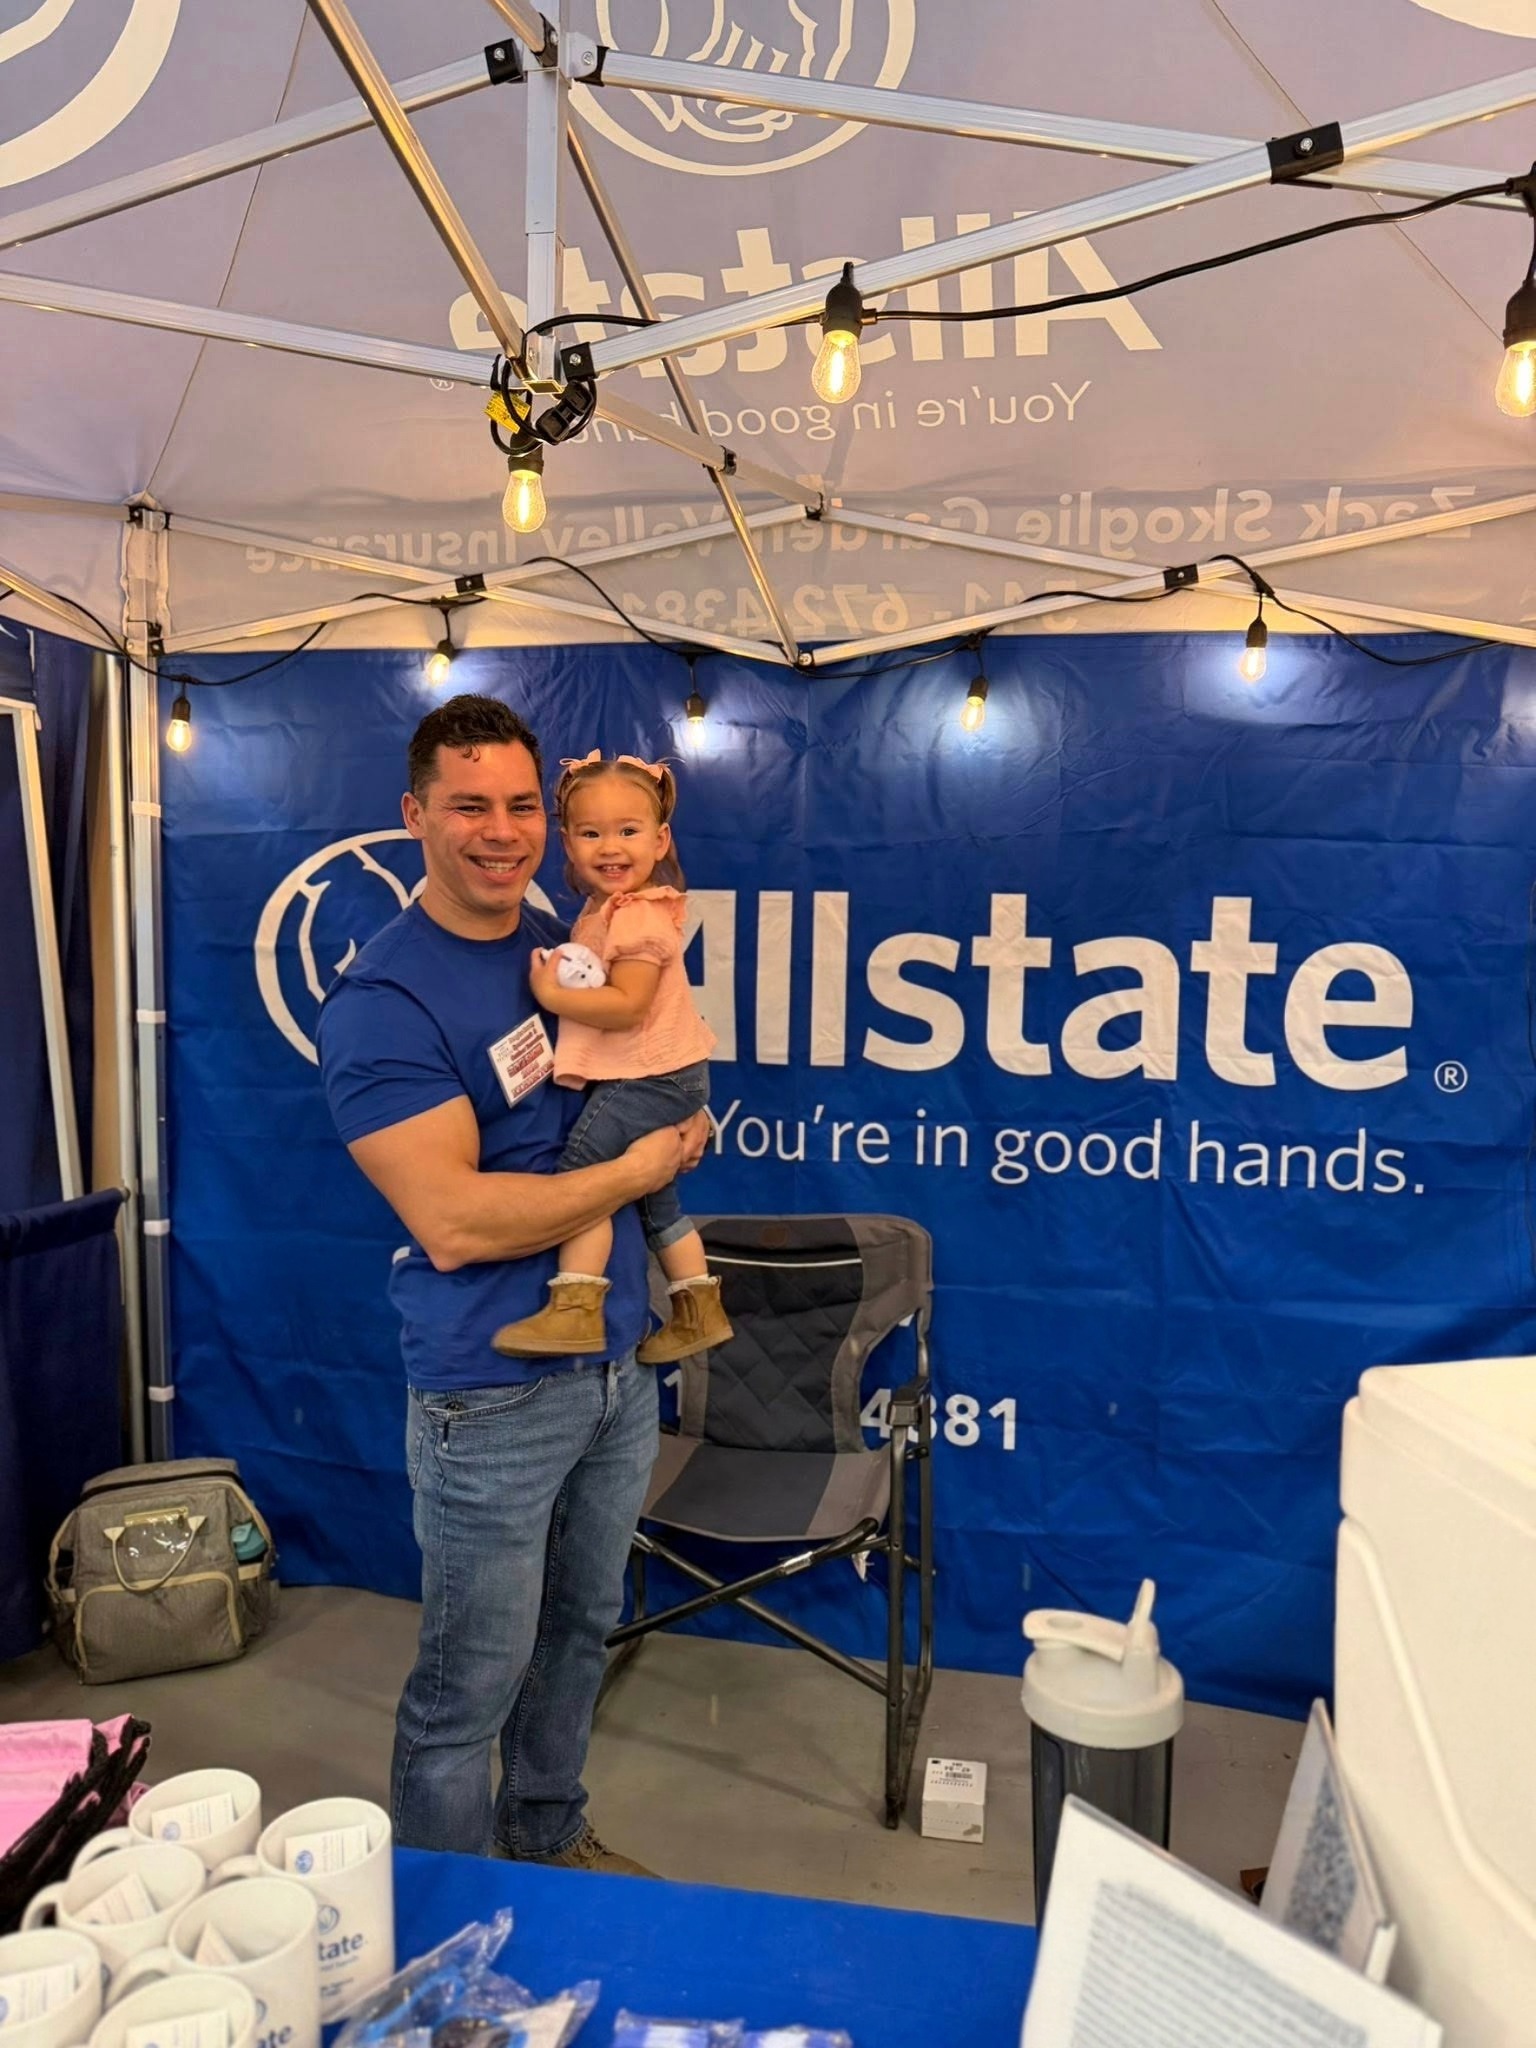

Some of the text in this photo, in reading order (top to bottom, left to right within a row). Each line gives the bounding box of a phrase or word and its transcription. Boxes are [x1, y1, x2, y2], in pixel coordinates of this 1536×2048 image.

[683, 889, 1413, 1091] Allstate
[703, 1099, 1424, 1194] You're in good hands.
